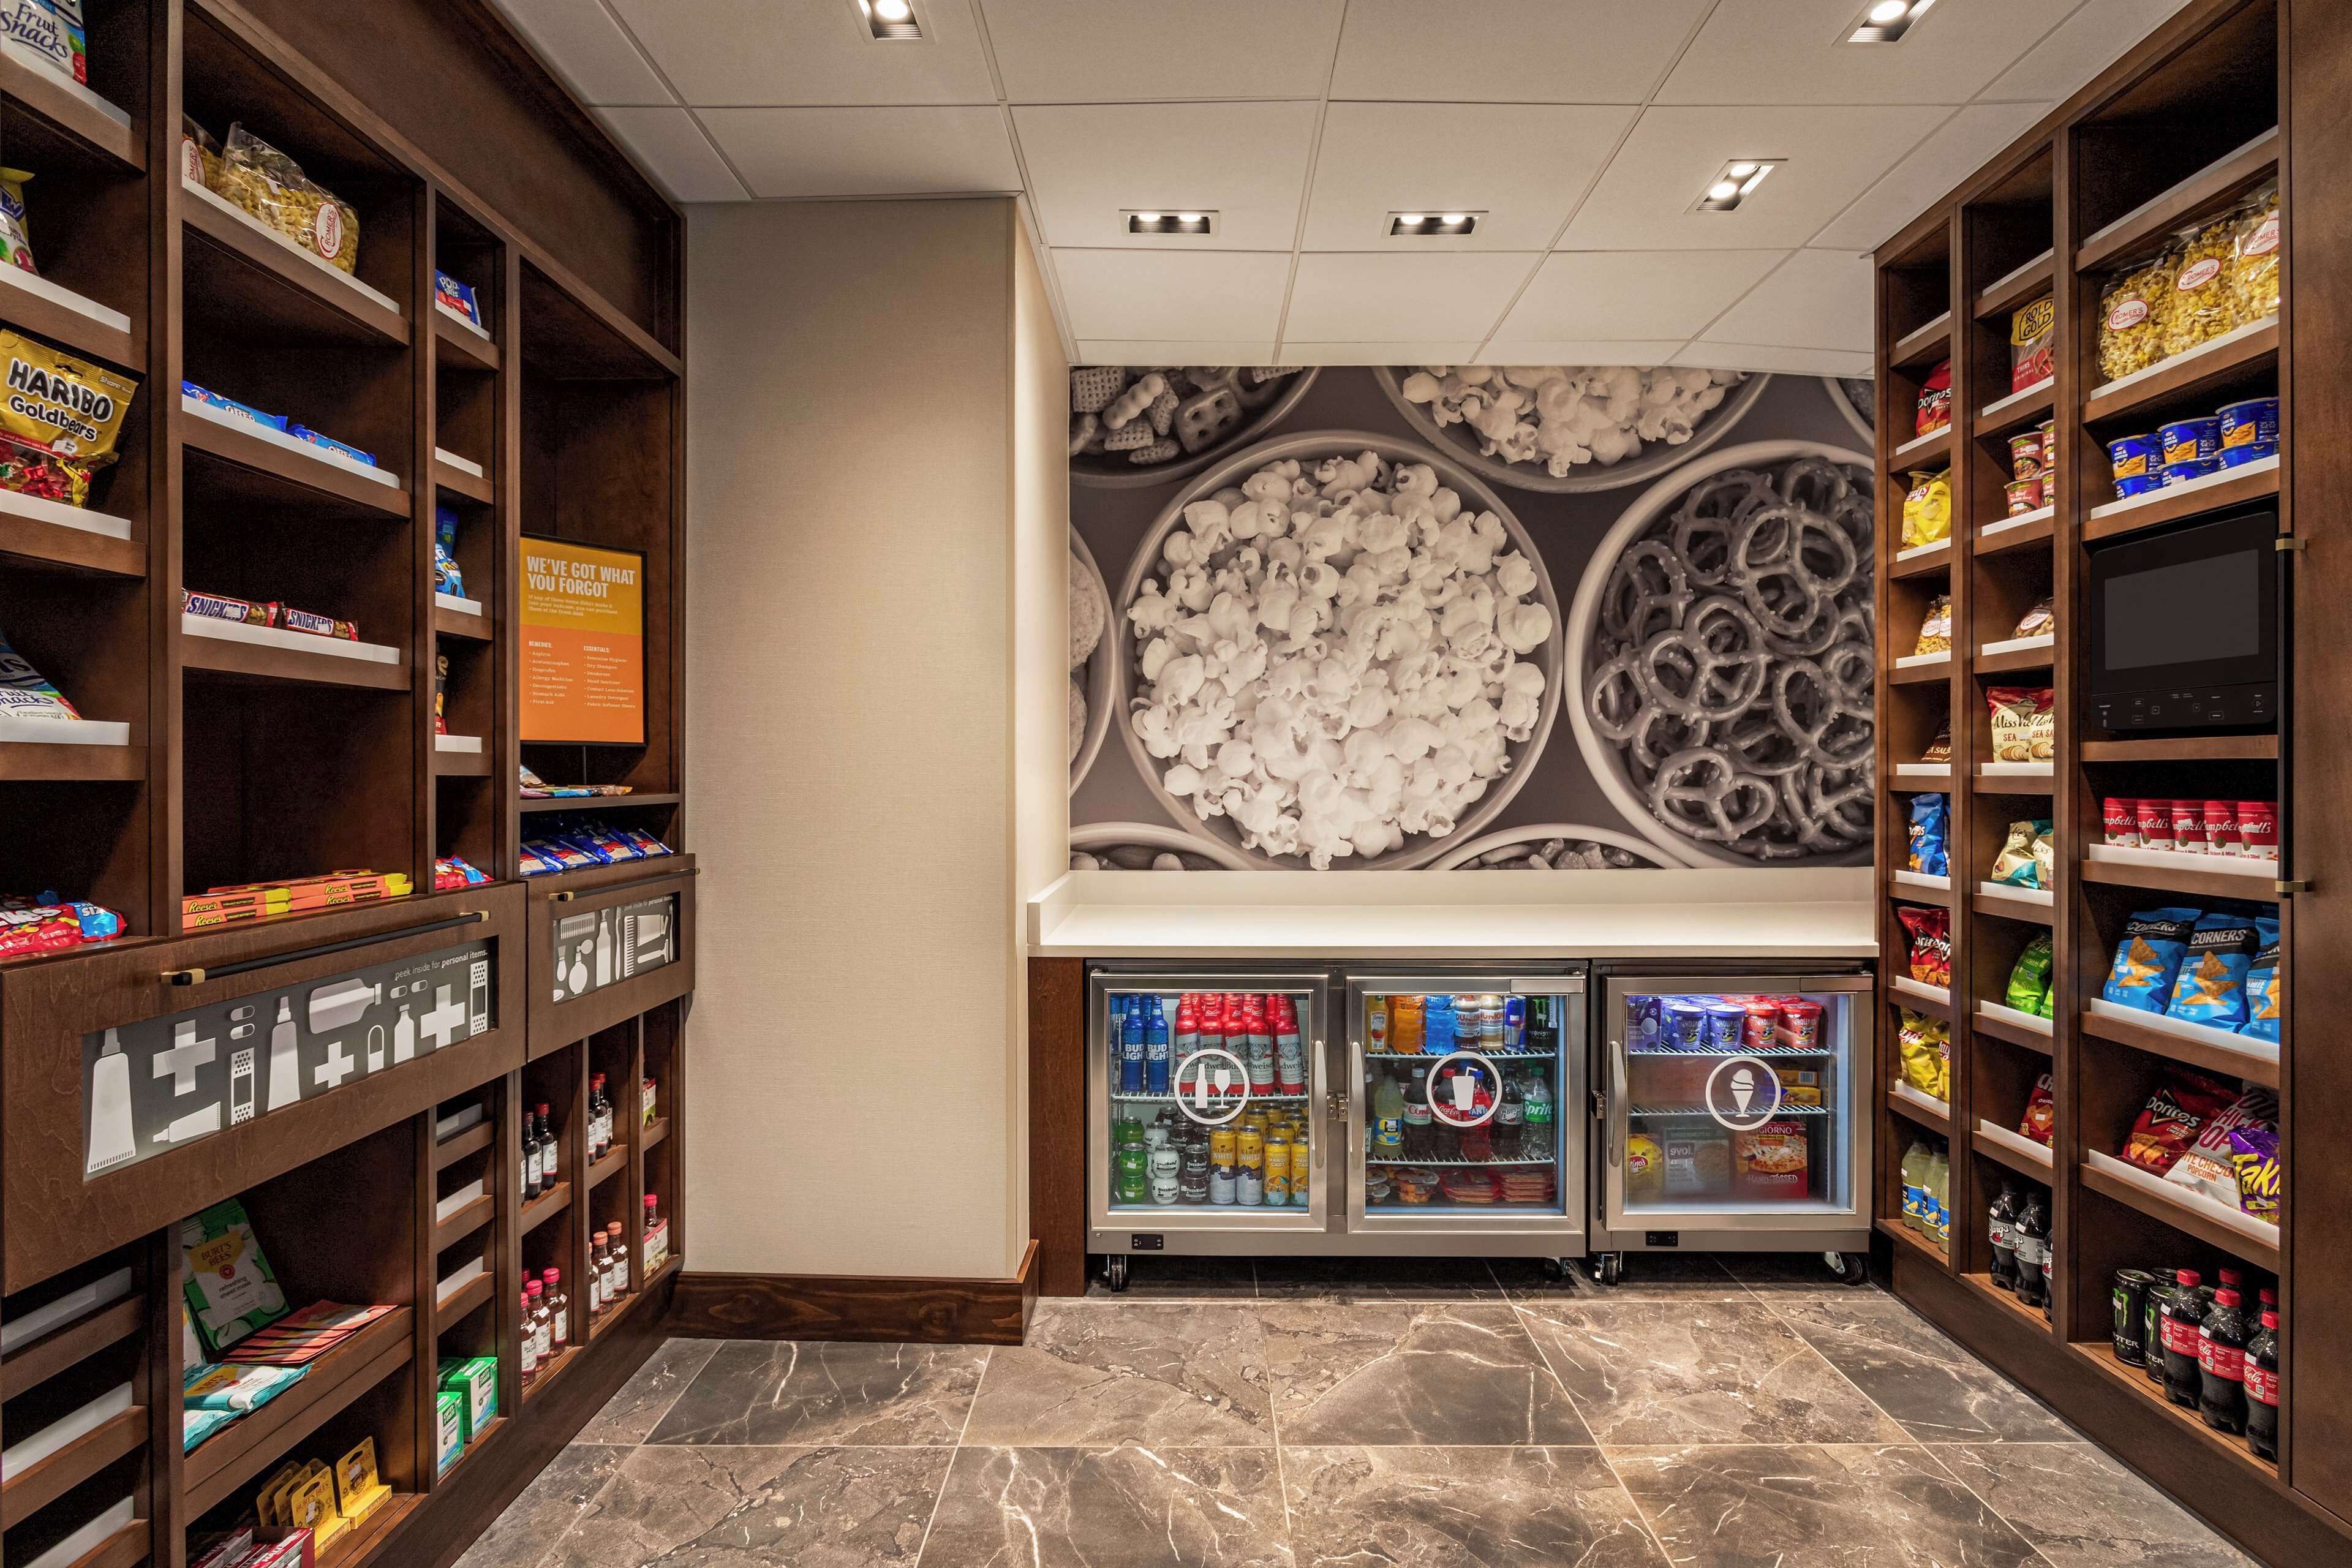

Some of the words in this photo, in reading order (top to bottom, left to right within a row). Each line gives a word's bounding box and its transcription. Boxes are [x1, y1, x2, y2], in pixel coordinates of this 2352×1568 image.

[15, 2, 59, 37] Fruit
[0, 11, 68, 58] Snacks
[2025, 300, 2052, 324] ROLD
[2023, 312, 2051, 337] GOLD
[7, 359, 114, 422] HARIBO
[1918, 388, 1951, 409] Doritos
[9, 396, 97, 442] Goldbears
[527, 556, 568, 576] WE'VE
[571, 562, 597, 579] GOT
[600, 566, 635, 585] WHAT
[527, 573, 555, 591] YOU
[559, 578, 609, 598] FORGOT
[0, 696, 55, 705] nacks
[1993, 714, 2018, 729] Miss
[2003, 733, 2017, 742] SEA
[2032, 730, 2044, 739] SEA
[2103, 815, 2136, 827] mpbell's
[2137, 818, 2168, 830] mpbell's
[189, 902, 217, 913] Reese's
[195, 915, 222, 927] Reese's
[2191, 930, 2247, 944] CORNERS
[395, 967, 411, 981] peek
[412, 963, 431, 973] inside
[432, 961, 441, 970] for
[442, 952, 468, 968] personal
[470, 949, 488, 960] items.
[1125, 1043, 1144, 1052] BUD
[1146, 1050, 1169, 1061] LIGHT
[1147, 1043, 1167, 1052] BUD
[1939, 1040, 1950, 1060] Lay
[2146, 1096, 2202, 1128] Doritos
[1630, 1156, 1646, 1167] tino's
[2187, 1164, 2217, 1183] POPCORN
[201, 1240, 232, 1261] BURT'S
[209, 1251, 232, 1267] BEES
[2244, 1366, 2265, 1384] Cola
